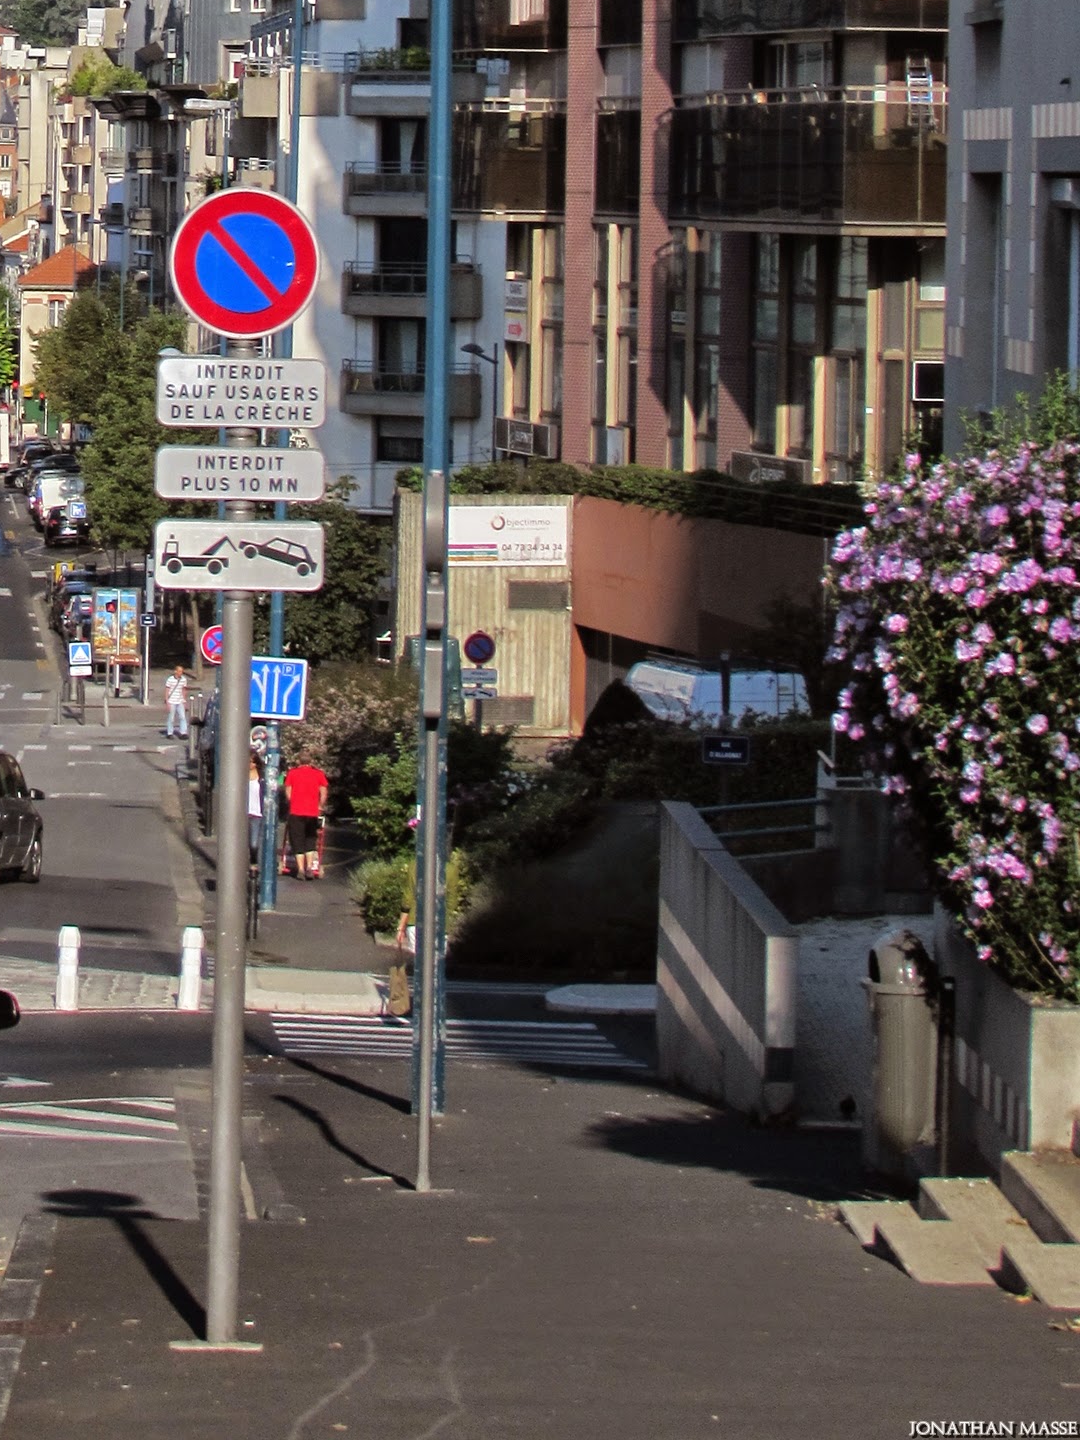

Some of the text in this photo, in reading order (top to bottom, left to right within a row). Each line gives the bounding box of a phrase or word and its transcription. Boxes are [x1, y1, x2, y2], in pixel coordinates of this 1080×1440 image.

[197, 365, 283, 380] INTERDIT
[166, 384, 318, 401] SAUF USAGERS
[171, 403, 312, 421] DE LA CRÈCHE
[197, 456, 283, 471] INTERDIT
[181, 477, 298, 492] PLUS 10 MN
[502, 543, 512, 551] 04
[515, 543, 525, 551] 73
